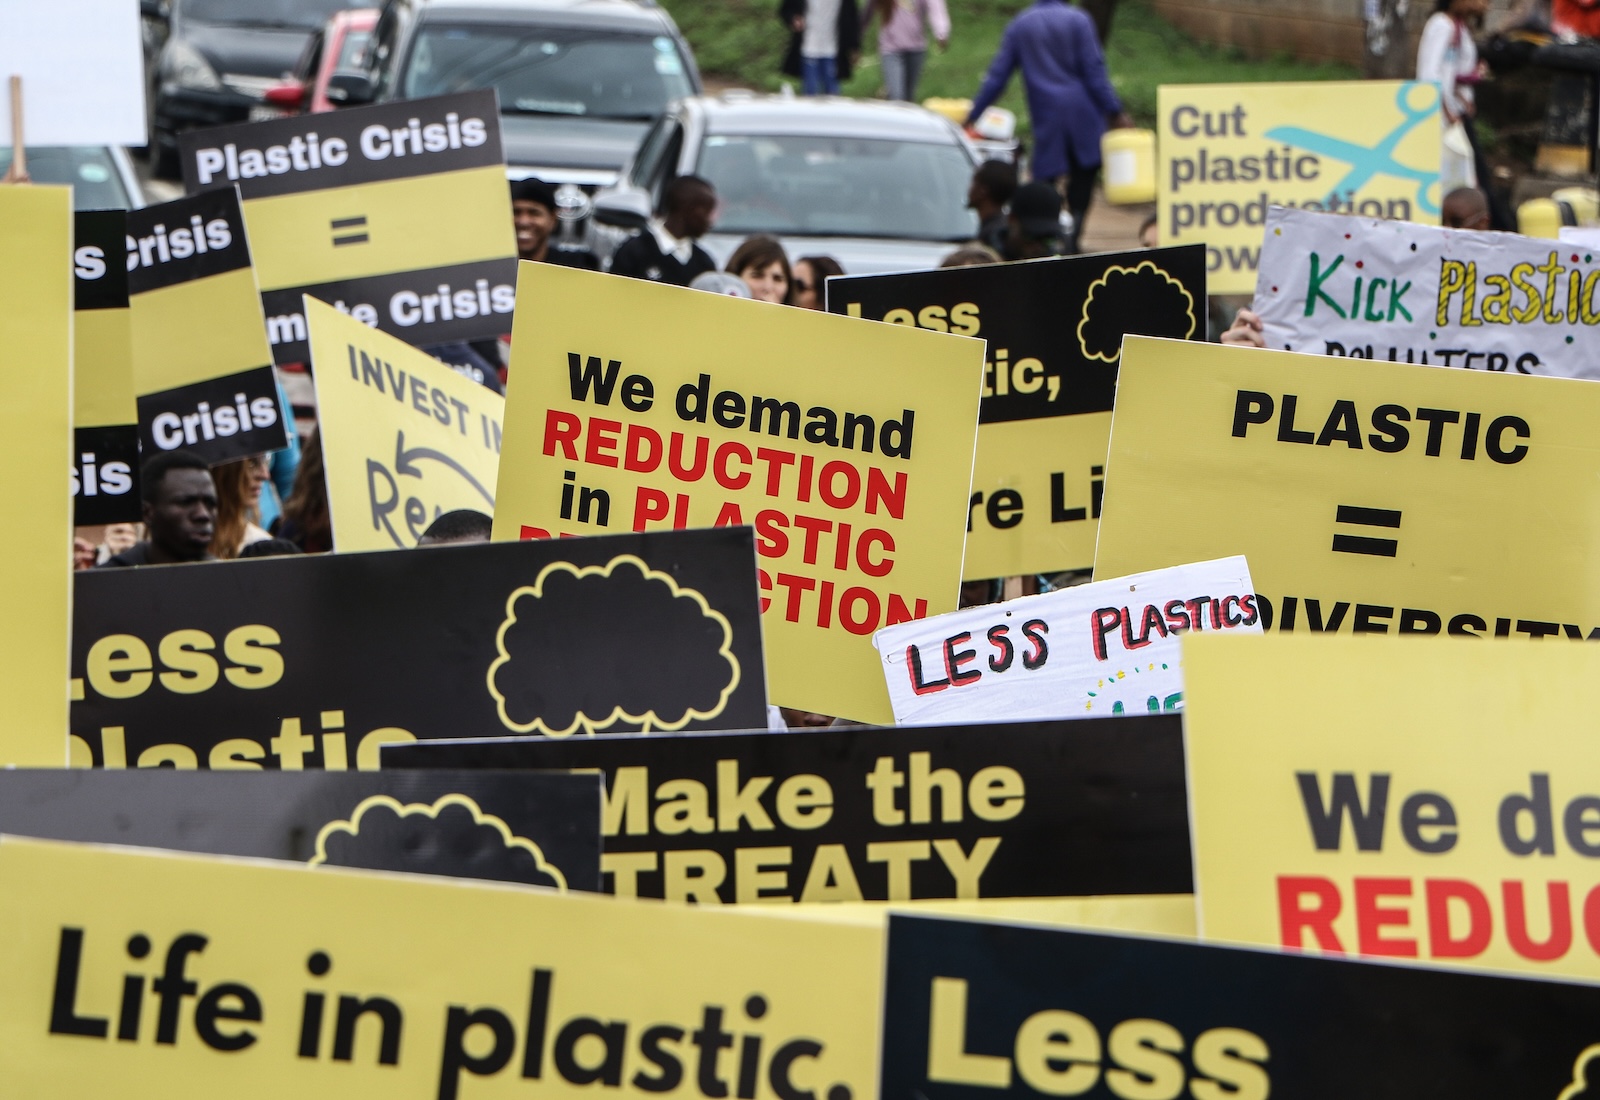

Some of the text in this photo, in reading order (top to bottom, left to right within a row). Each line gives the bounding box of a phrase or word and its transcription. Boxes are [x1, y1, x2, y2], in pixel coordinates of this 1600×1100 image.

[196, 112, 487, 184] Plastic Crisis
[1171, 104, 1247, 137] Cut
[1171, 147, 1320, 192] plastic
[390, 279, 515, 326] Crisis
[152, 392, 277, 450] Crisis
[347, 343, 469, 436] INVEST
[568, 353, 654, 412] We
[676, 373, 914, 459] demand
[1232, 390, 1530, 464] PLASTIC
[543, 409, 907, 520] REDUCTION
[560, 470, 610, 527] in
[70, 624, 285, 700] ess
[906, 594, 1258, 695] LESS PLASTICS
[866, 752, 1024, 826] the
[1295, 772, 1600, 859] We de
[601, 837, 1002, 904] TREATY
[1276, 875, 1600, 962] REDU
[49, 926, 263, 1051] Life
[297, 950, 403, 1066] in
[927, 977, 1270, 1100] Less
